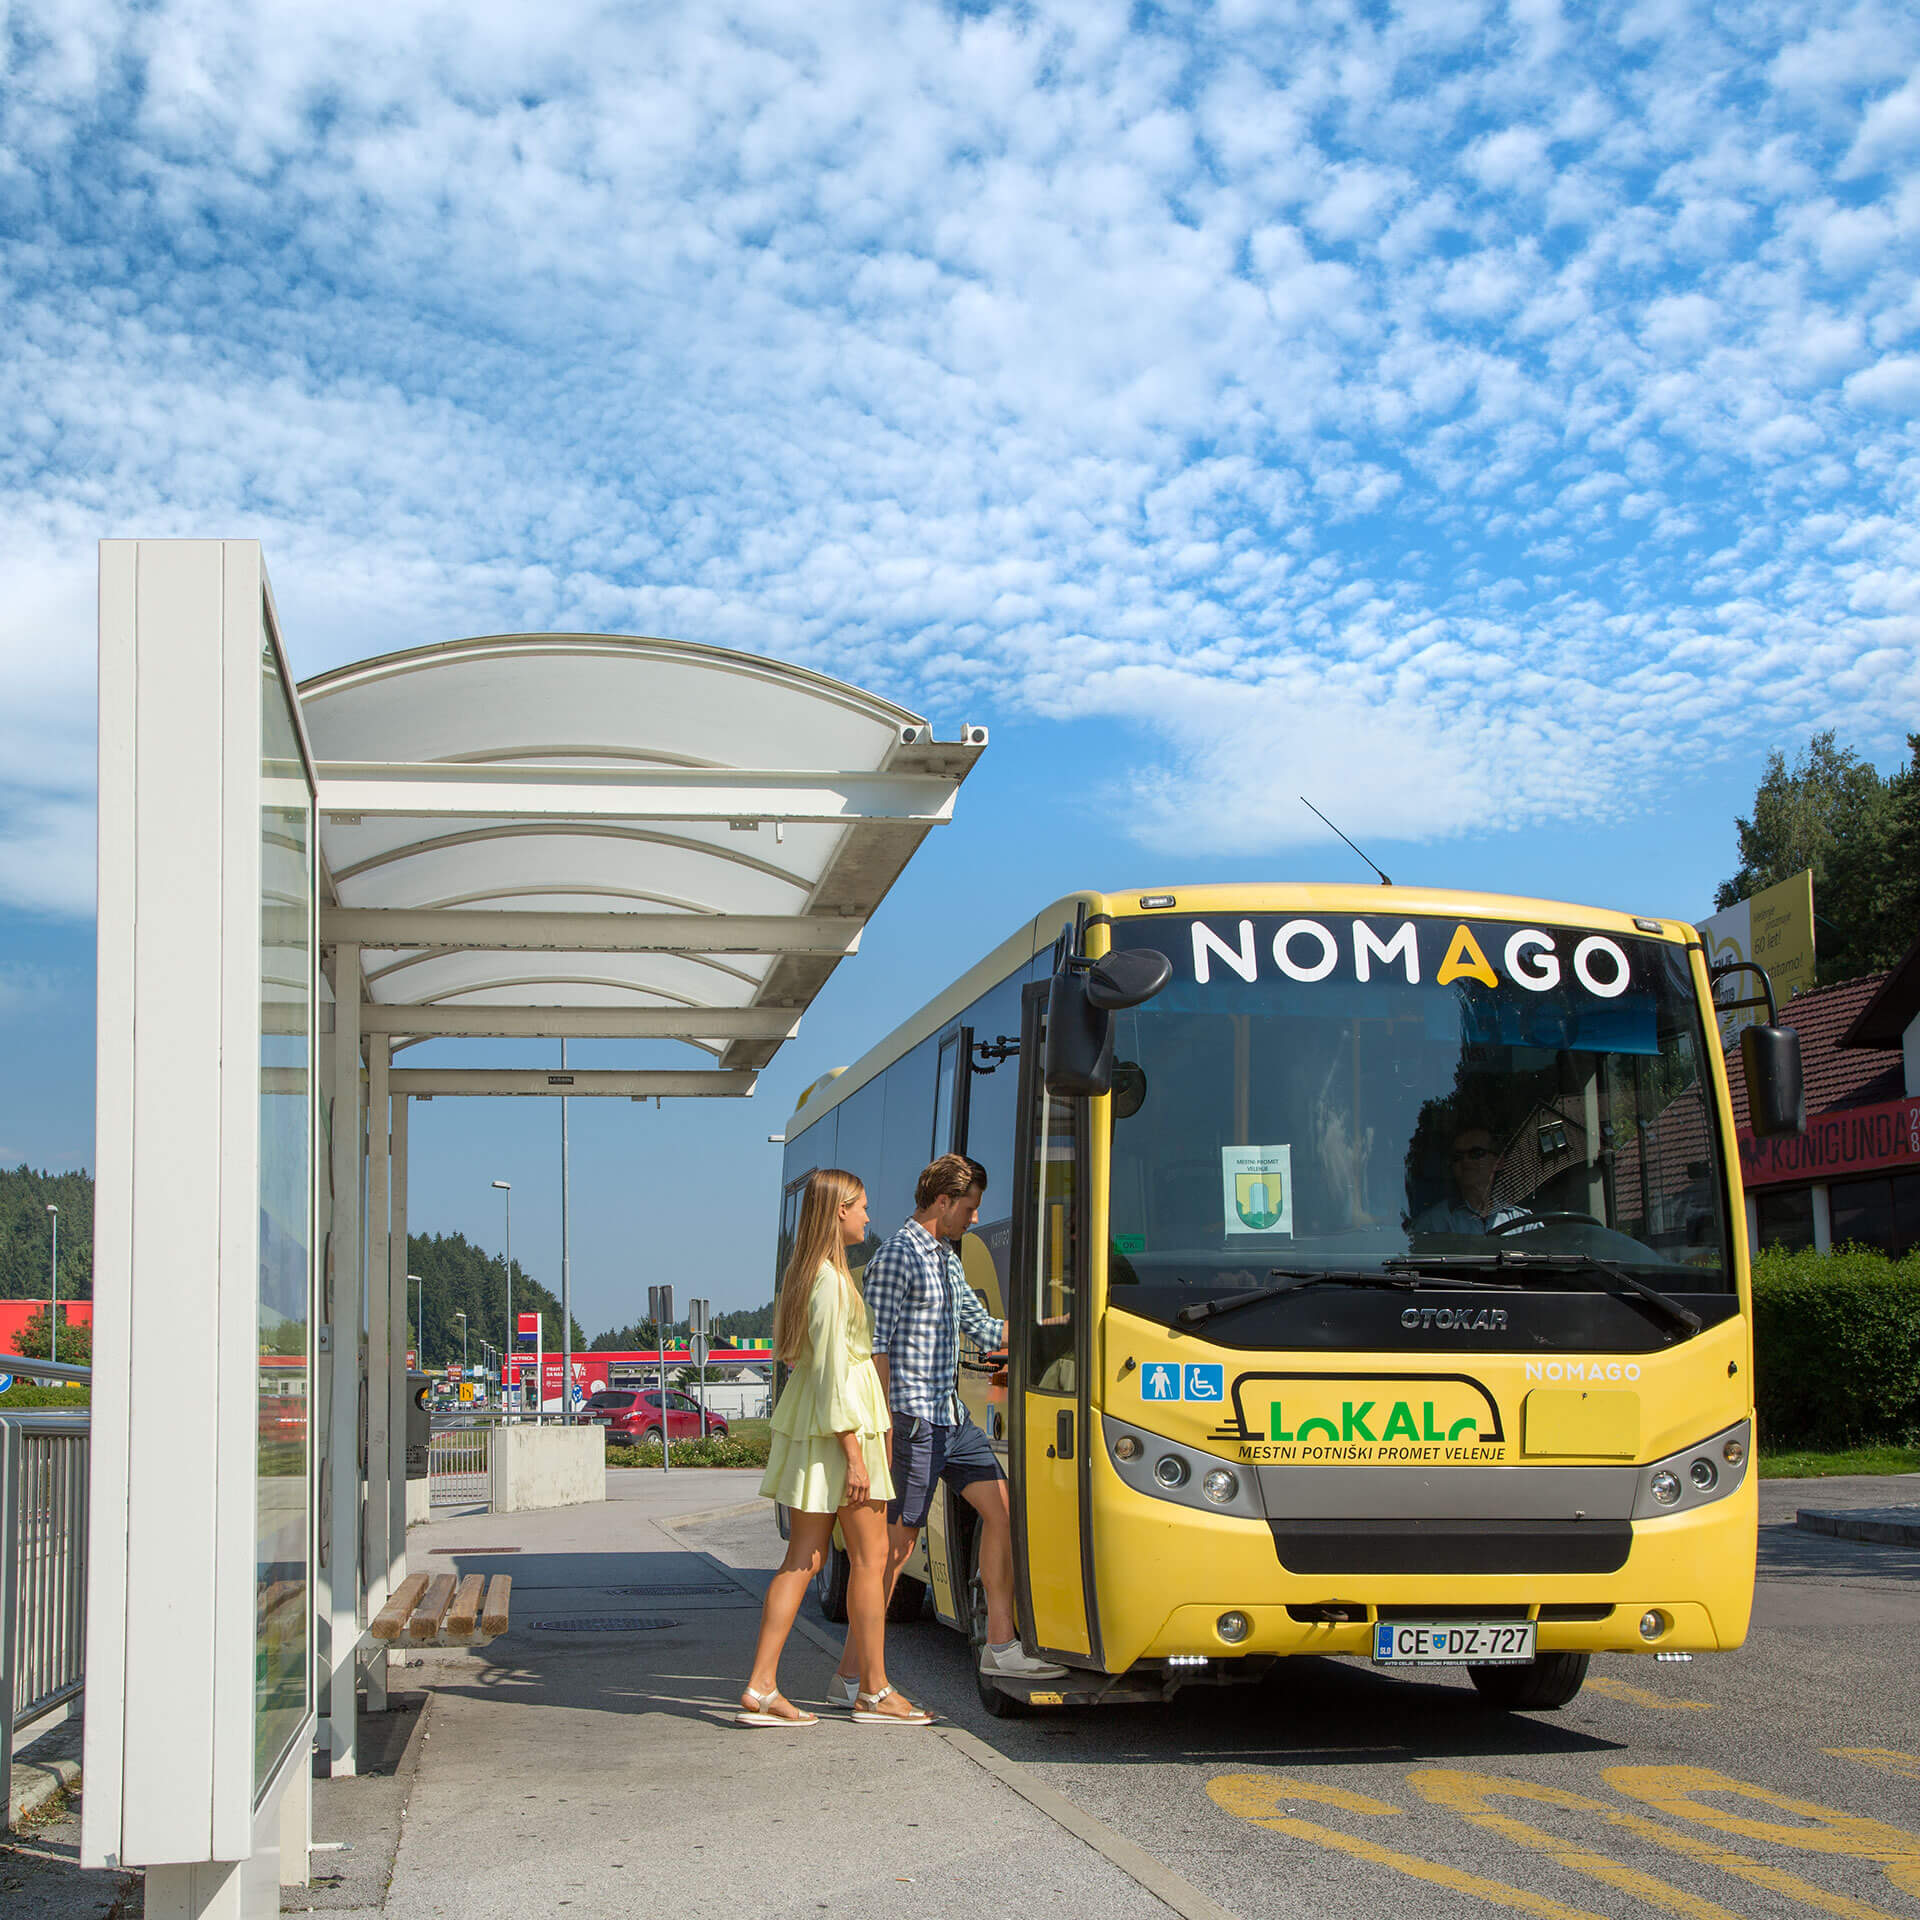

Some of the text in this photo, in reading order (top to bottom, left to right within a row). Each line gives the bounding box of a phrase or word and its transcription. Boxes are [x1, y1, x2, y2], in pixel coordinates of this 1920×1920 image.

[1755, 936, 1765, 954] 60
[1191, 919, 1631, 998] NOMAGO
[1400, 1308, 1508, 1331] OTOKAR
[1525, 1362, 1641, 1381] NOMAGO
[1238, 1444, 1506, 1460] MESTNI POTNIŠKI PROMET VELENJE
[1397, 1628, 1529, 1654] CE DZ-727
